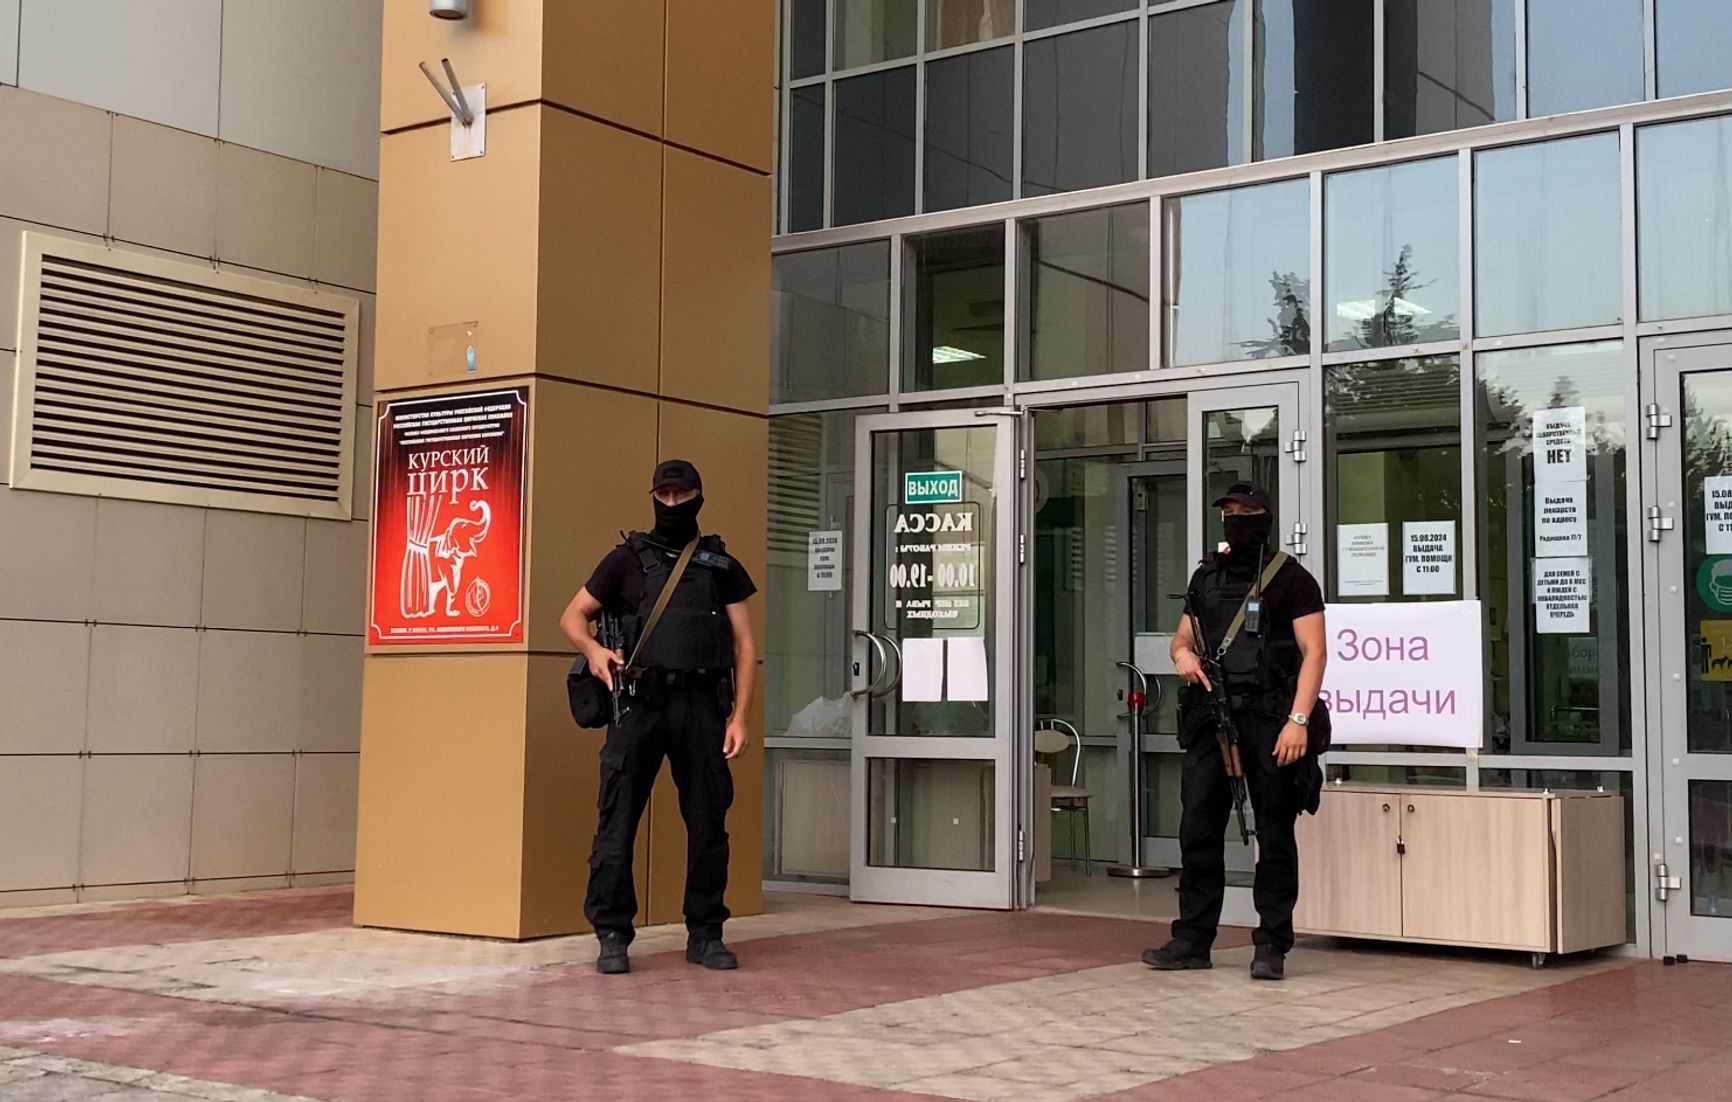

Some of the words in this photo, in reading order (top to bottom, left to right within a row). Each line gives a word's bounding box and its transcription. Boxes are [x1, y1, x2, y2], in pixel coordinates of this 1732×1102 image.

[408, 445, 489, 472] КУРСКИЙ
[1547, 449, 1571, 464] НЕТ
[908, 479, 958, 497] ВЫХОД
[1410, 534, 1447, 542] 15.08.2024
[1413, 544, 1443, 553] ВЫДАЧА
[1421, 555, 1452, 563] ПОМОЩИ
[1336, 628, 1429, 661] Зона
